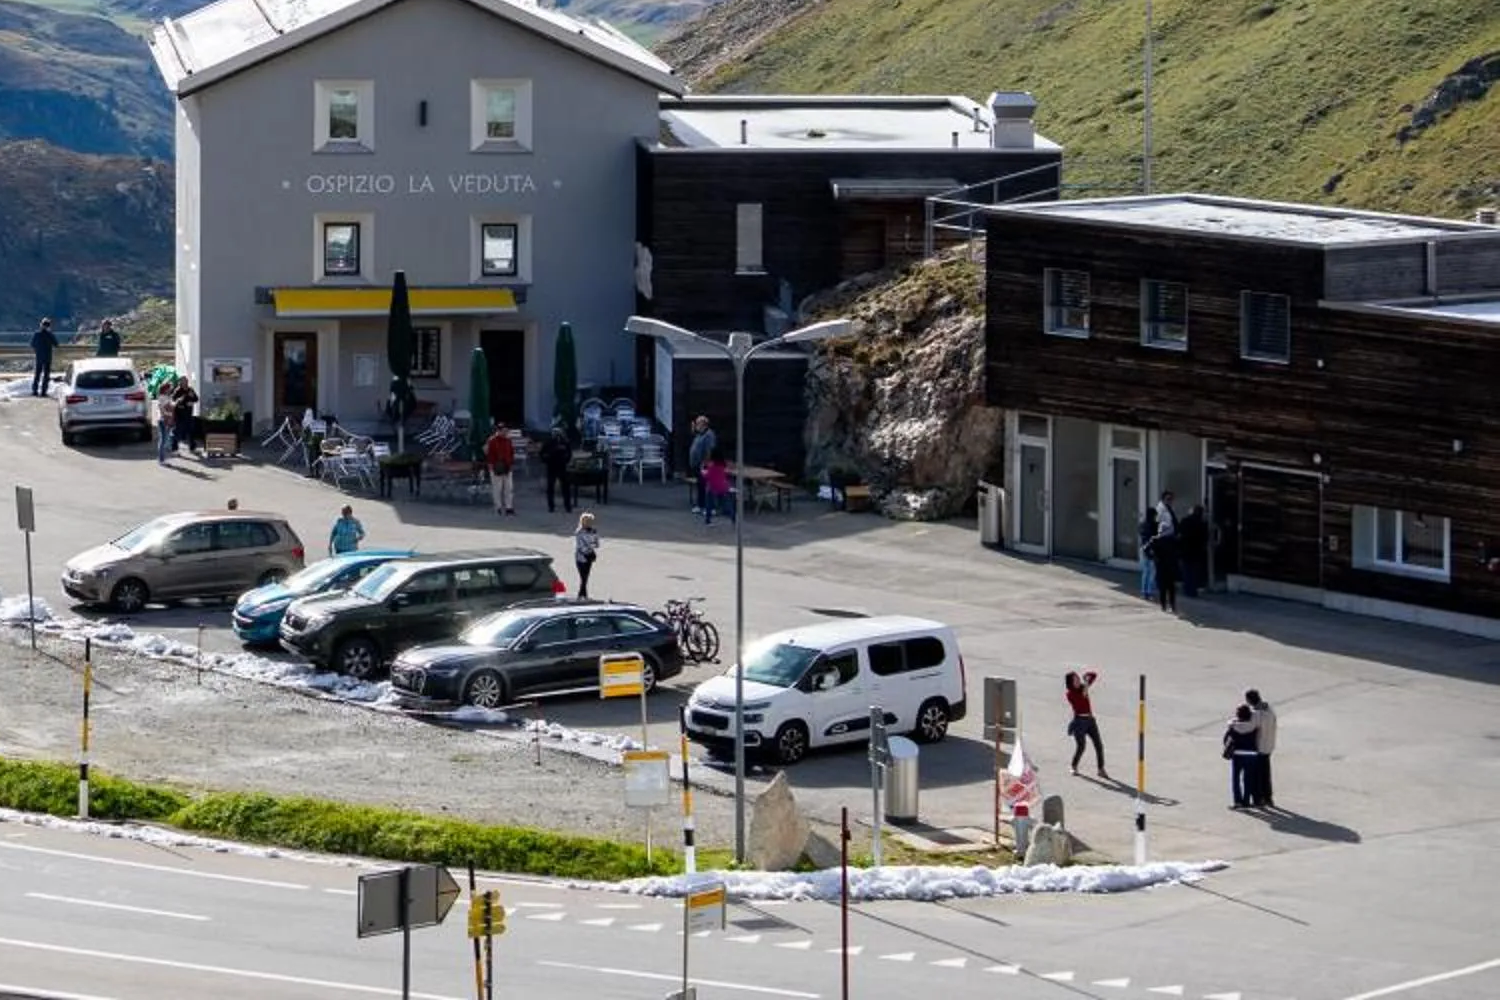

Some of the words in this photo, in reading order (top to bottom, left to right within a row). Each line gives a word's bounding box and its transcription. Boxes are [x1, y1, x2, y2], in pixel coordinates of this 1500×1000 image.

[306, 174, 396, 193] OSPIZIO
[408, 174, 435, 193] LA
[448, 174, 537, 193] VEDUTA
